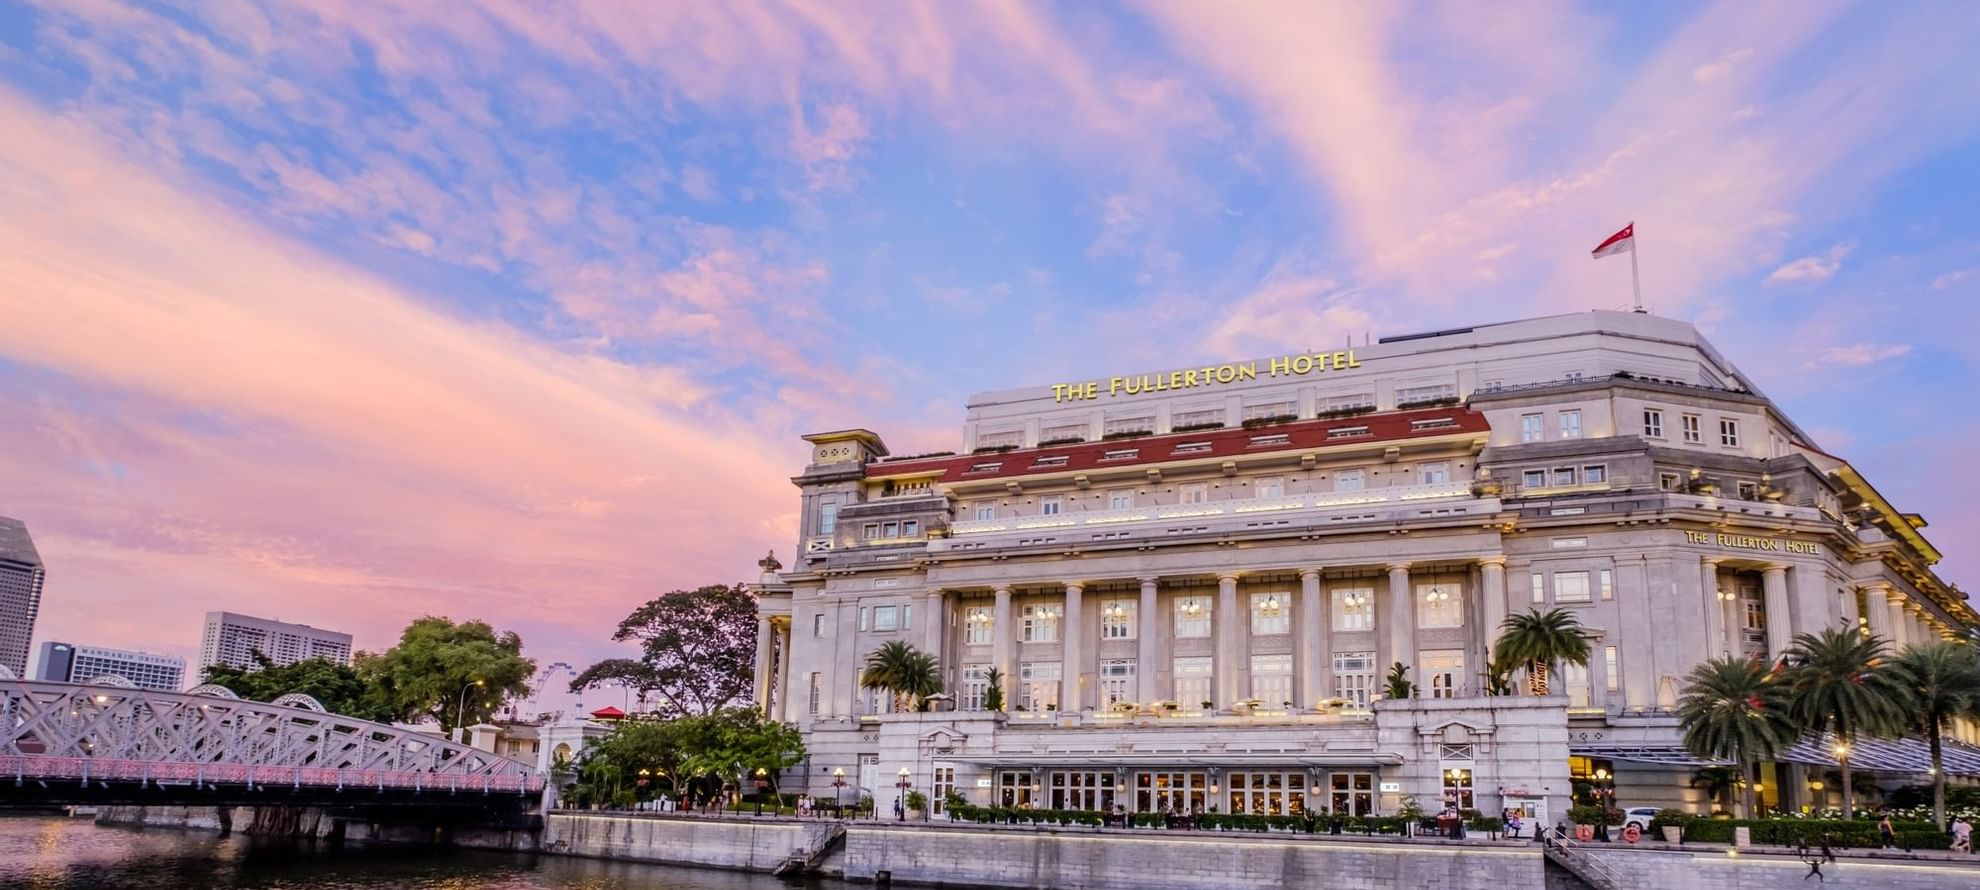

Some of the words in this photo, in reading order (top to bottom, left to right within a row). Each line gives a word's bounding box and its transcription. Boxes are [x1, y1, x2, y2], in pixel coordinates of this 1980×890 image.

[1052, 382, 1097, 402] THE
[1110, 362, 1257, 396] FULLERTON
[1269, 350, 1361, 377] HOTEL
[1686, 530, 1709, 544] THE
[1717, 533, 1778, 551] FULLERTON
[1785, 540, 1820, 555] HOTEL
[82, 648, 133, 658] MANDARIN
[138, 655, 182, 665] ORIENTAL
